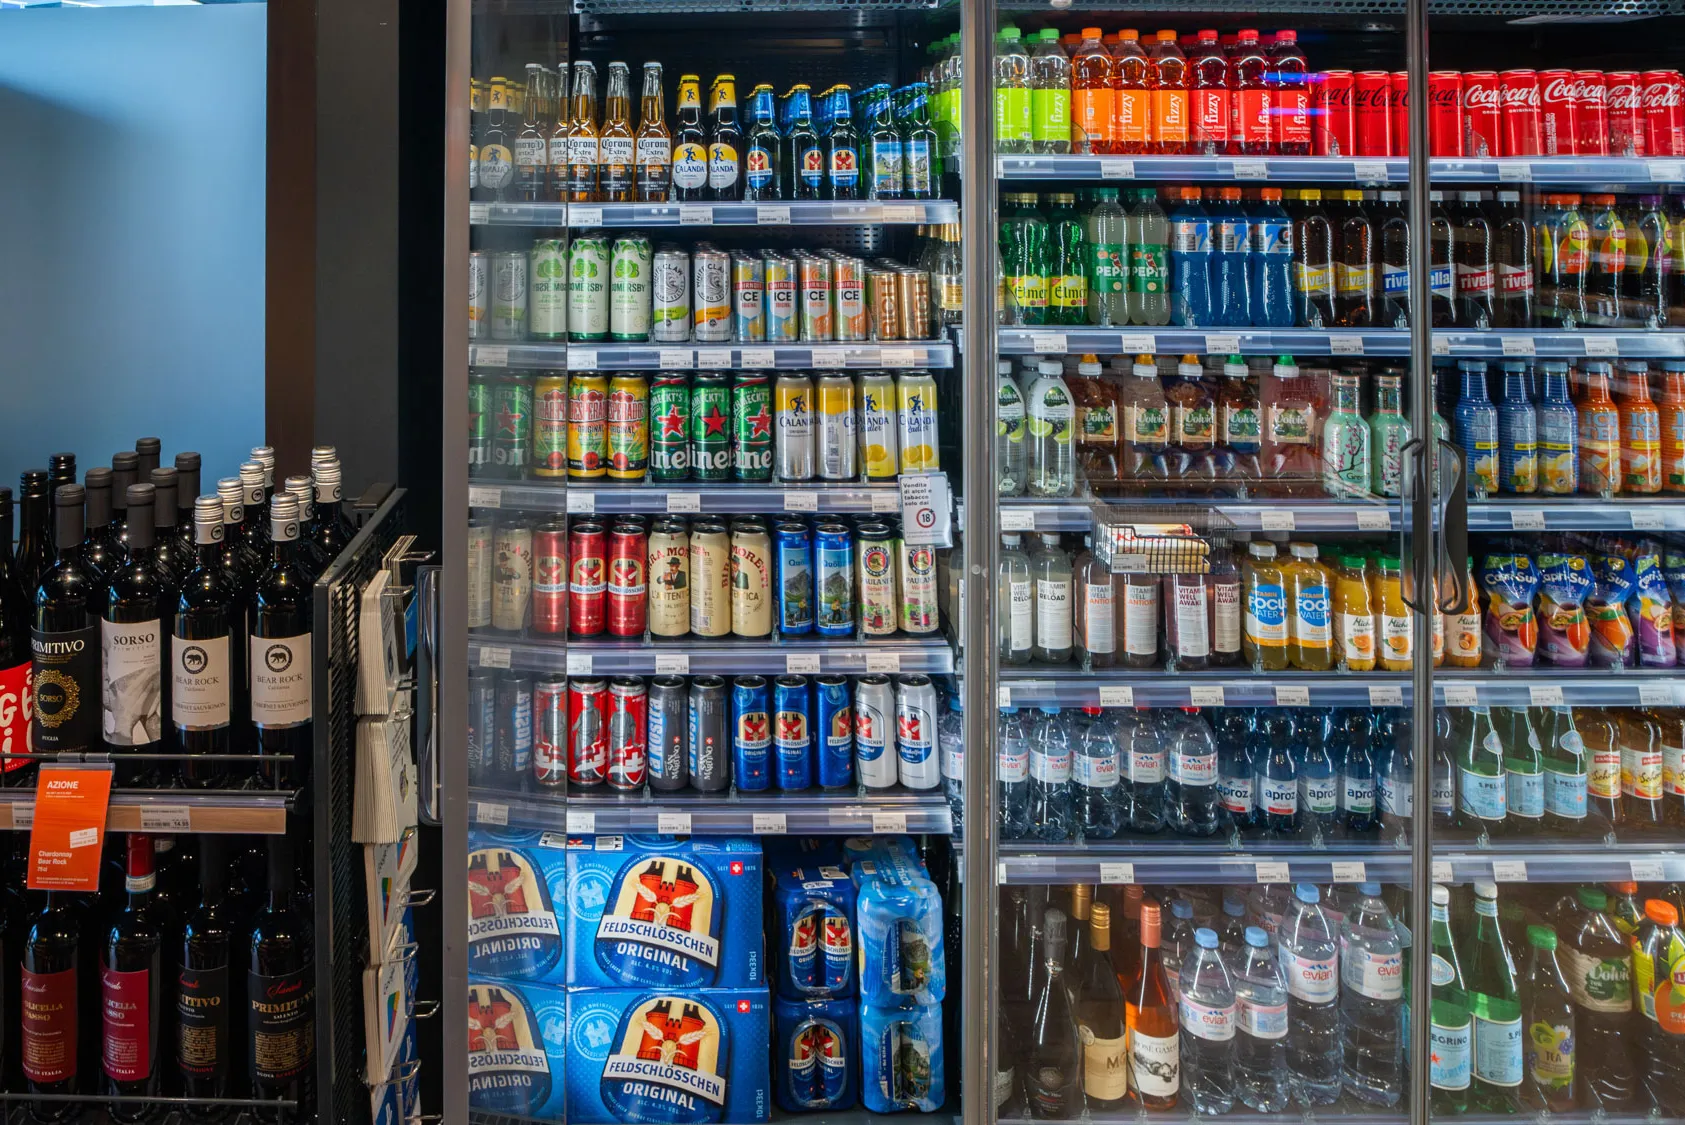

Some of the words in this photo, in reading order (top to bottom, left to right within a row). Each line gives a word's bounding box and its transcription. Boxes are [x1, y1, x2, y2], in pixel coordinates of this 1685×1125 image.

[1642, 83, 1680, 107] Cola
[1050, 92, 1065, 123] fizzy
[1119, 92, 1135, 124] fizzy
[1166, 93, 1182, 124] fizzy
[1204, 92, 1221, 123] fizzy
[1294, 93, 1308, 125] fizzy
[568, 140, 598, 153] Corona
[601, 140, 632, 153] Corona
[638, 140, 669, 153] Corona
[574, 152, 592, 160] Extra
[608, 152, 627, 160] Extra
[645, 152, 664, 161] Extra
[675, 164, 705, 174] CALANDA
[774, 291, 792, 301] ICE
[841, 290, 859, 301] ICE
[1039, 593, 1066, 601] RELOAD
[113, 633, 156, 646] SORSO
[176, 675, 193, 686] BEAR
[196, 675, 221, 687] ROCK
[256, 675, 276, 686] BEAR
[278, 673, 304, 685] ROCK
[40, 694, 63, 703] SORSO
[1135, 760, 1158, 769] evian
[1182, 762, 1206, 770] evian
[47, 780, 79, 790] AZIONE
[1265, 788, 1295, 802] aproz
[52, 857, 67, 866] Rock
[603, 920, 714, 960] FELDSCHLÖSSCHEN
[616, 942, 690, 972] ORIGINAL
[749, 951, 757, 981] 10x33cl
[1302, 969, 1333, 981] evian
[1202, 1014, 1229, 1024] evian
[1545, 1051, 1563, 1063] TEA
[609, 1060, 721, 1097] FELDSCHLÖSSCHEN
[622, 1082, 697, 1112] ORIGINAL
[756, 1089, 764, 1119] 10x33cl
